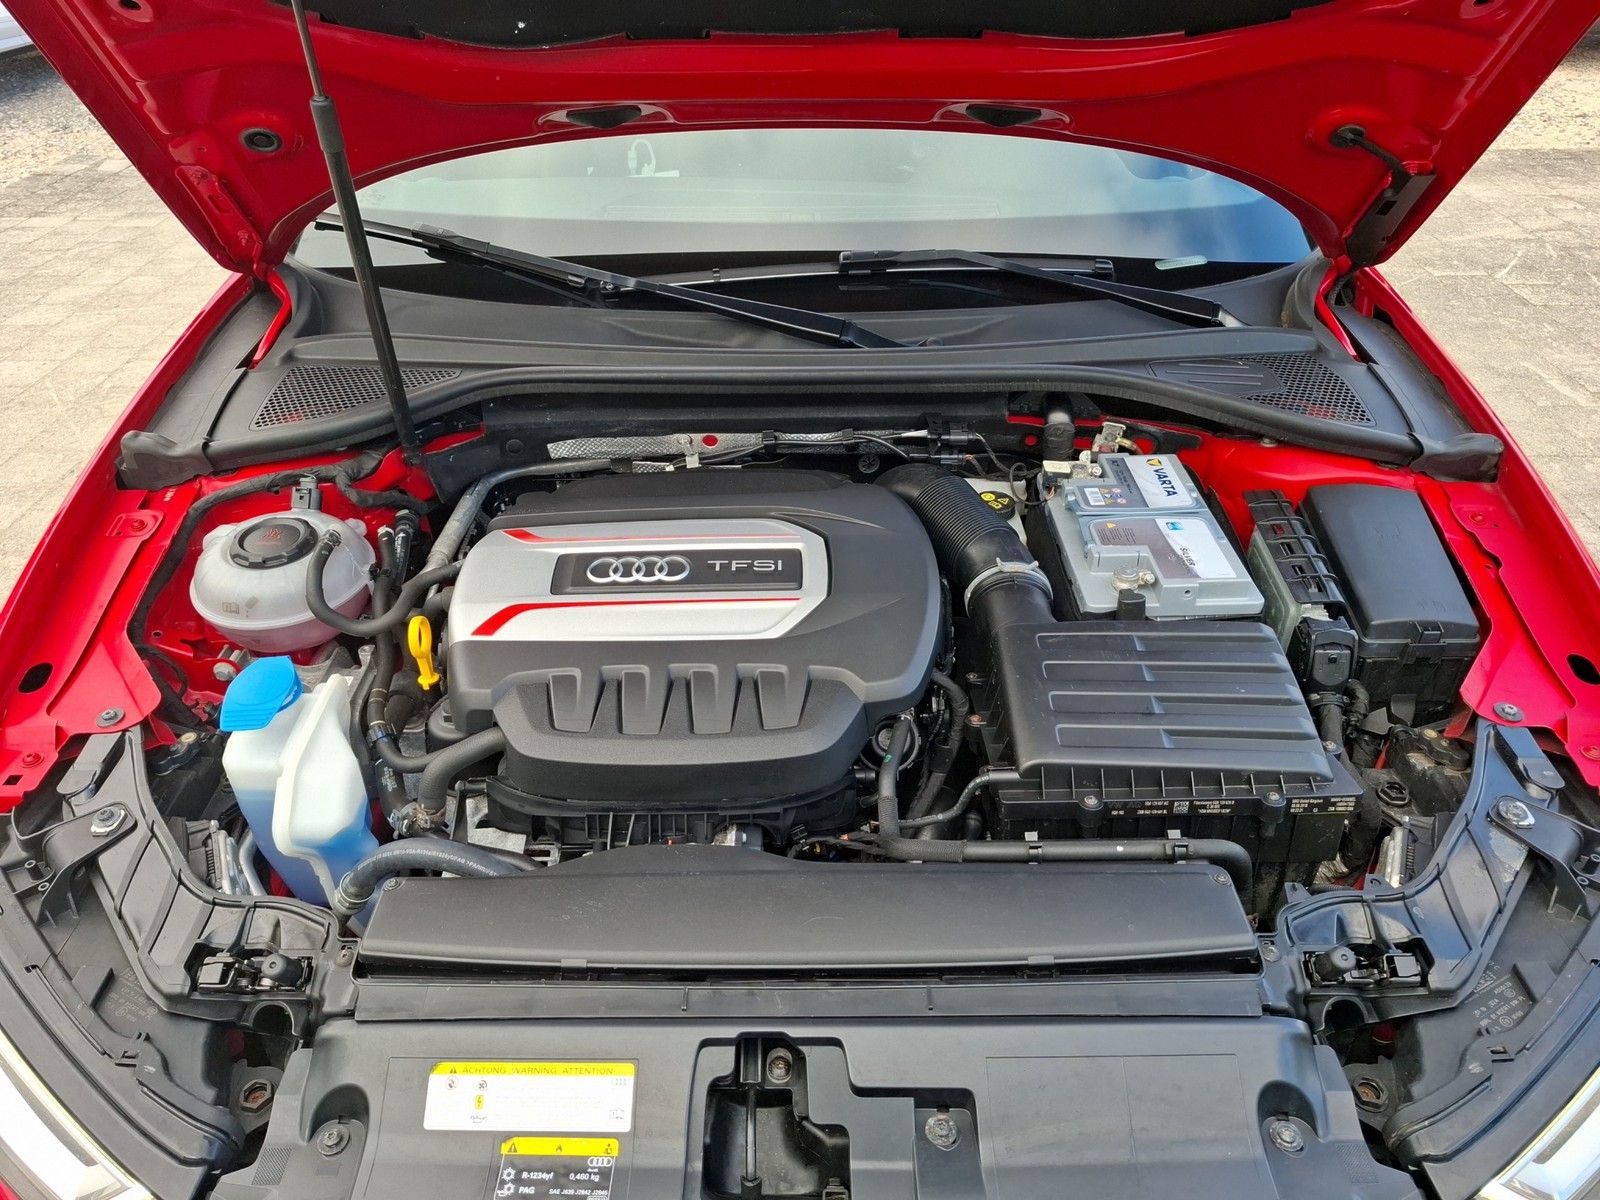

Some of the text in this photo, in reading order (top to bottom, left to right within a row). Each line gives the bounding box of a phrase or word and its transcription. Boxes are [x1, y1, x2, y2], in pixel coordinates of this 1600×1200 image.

[1153, 467, 1178, 497] VARTA
[707, 559, 783, 572] TFSI
[512, 1067, 557, 1075] WARNING
[521, 1172, 554, 1180] R-1234yf
[590, 1173, 600, 1182] kg
